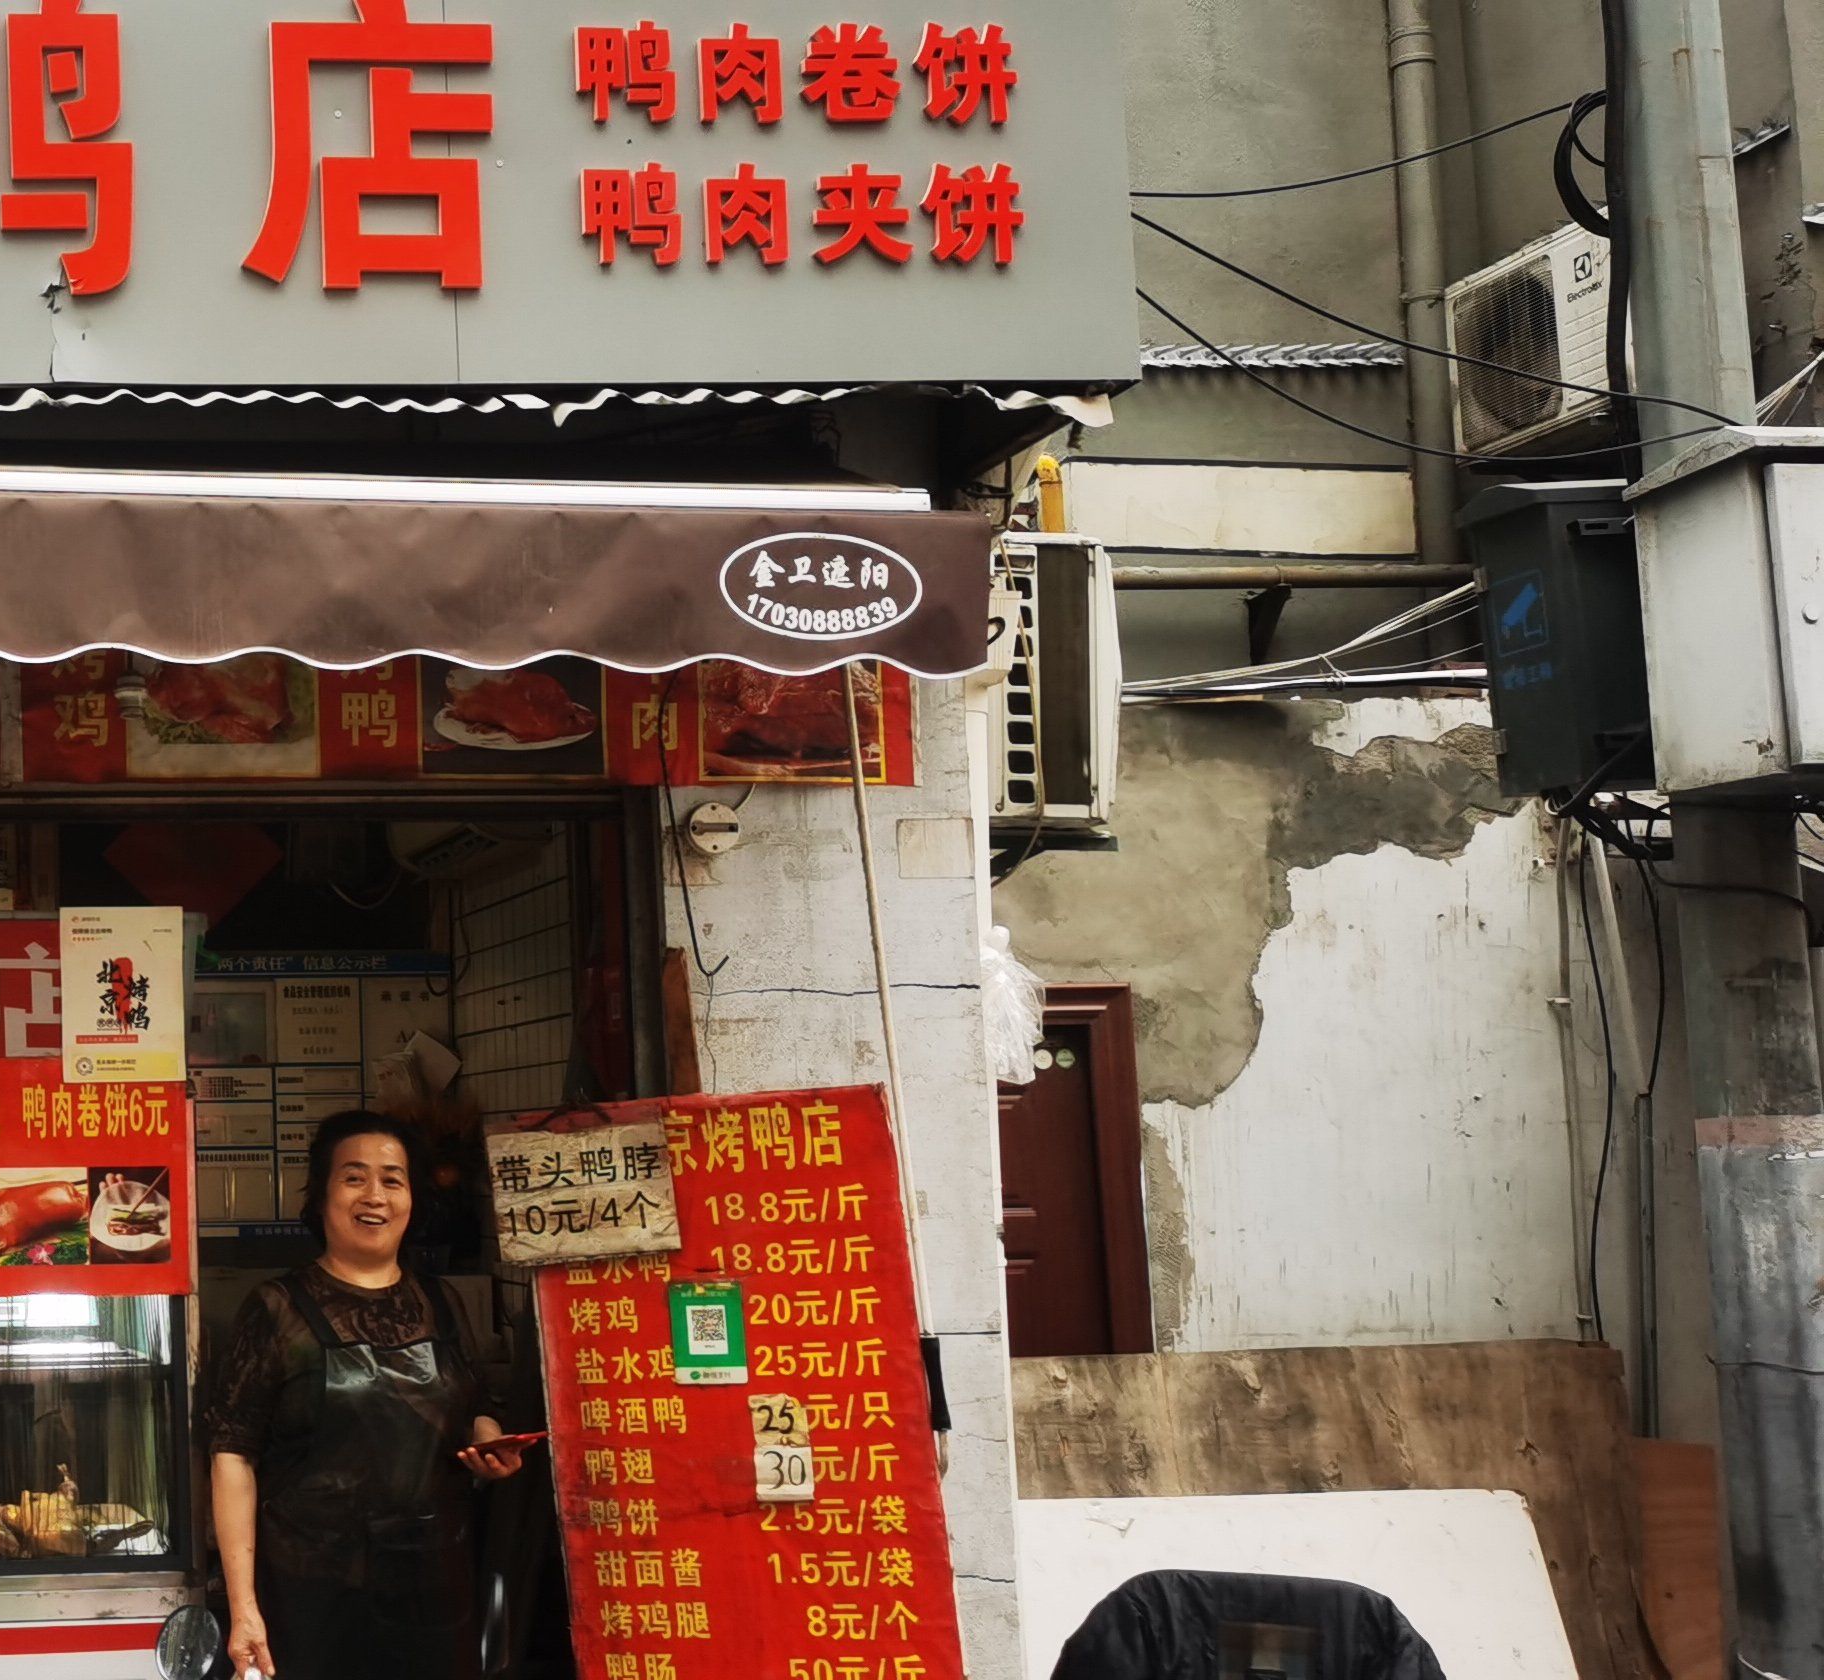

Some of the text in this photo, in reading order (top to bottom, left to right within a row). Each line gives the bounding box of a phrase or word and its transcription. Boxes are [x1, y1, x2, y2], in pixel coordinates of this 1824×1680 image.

[575, 20, 1018, 124] 鸭肉卷饼
[580, 162, 1024, 266] 鸭肉夹饼
[749, 550, 889, 590] 金卫遮阳
[747, 593, 898, 633] 17030888839
[22, 1083, 170, 1140] 鸭肉卷饼6元
[496, 1141, 663, 1195] 带头鸭脖
[503, 1189, 660, 1237] 10元/4个
[705, 1183, 868, 1225] 18.8元/斤
[710, 1235, 875, 1276] 18.8元/斤
[568, 1286, 882, 1336] 烤鸡 20元/斤
[753, 1338, 887, 1379] 25元/斤
[581, 1395, 687, 1436] 啤酒鸭
[584, 1448, 656, 1486] 鸭翅
[589, 1496, 908, 1537] 鸭饼 2.5元/袋
[594, 1547, 915, 1588] 甜面酱 1.5元/袋
[601, 1600, 919, 1641] 烤鸡腿 8元/个
